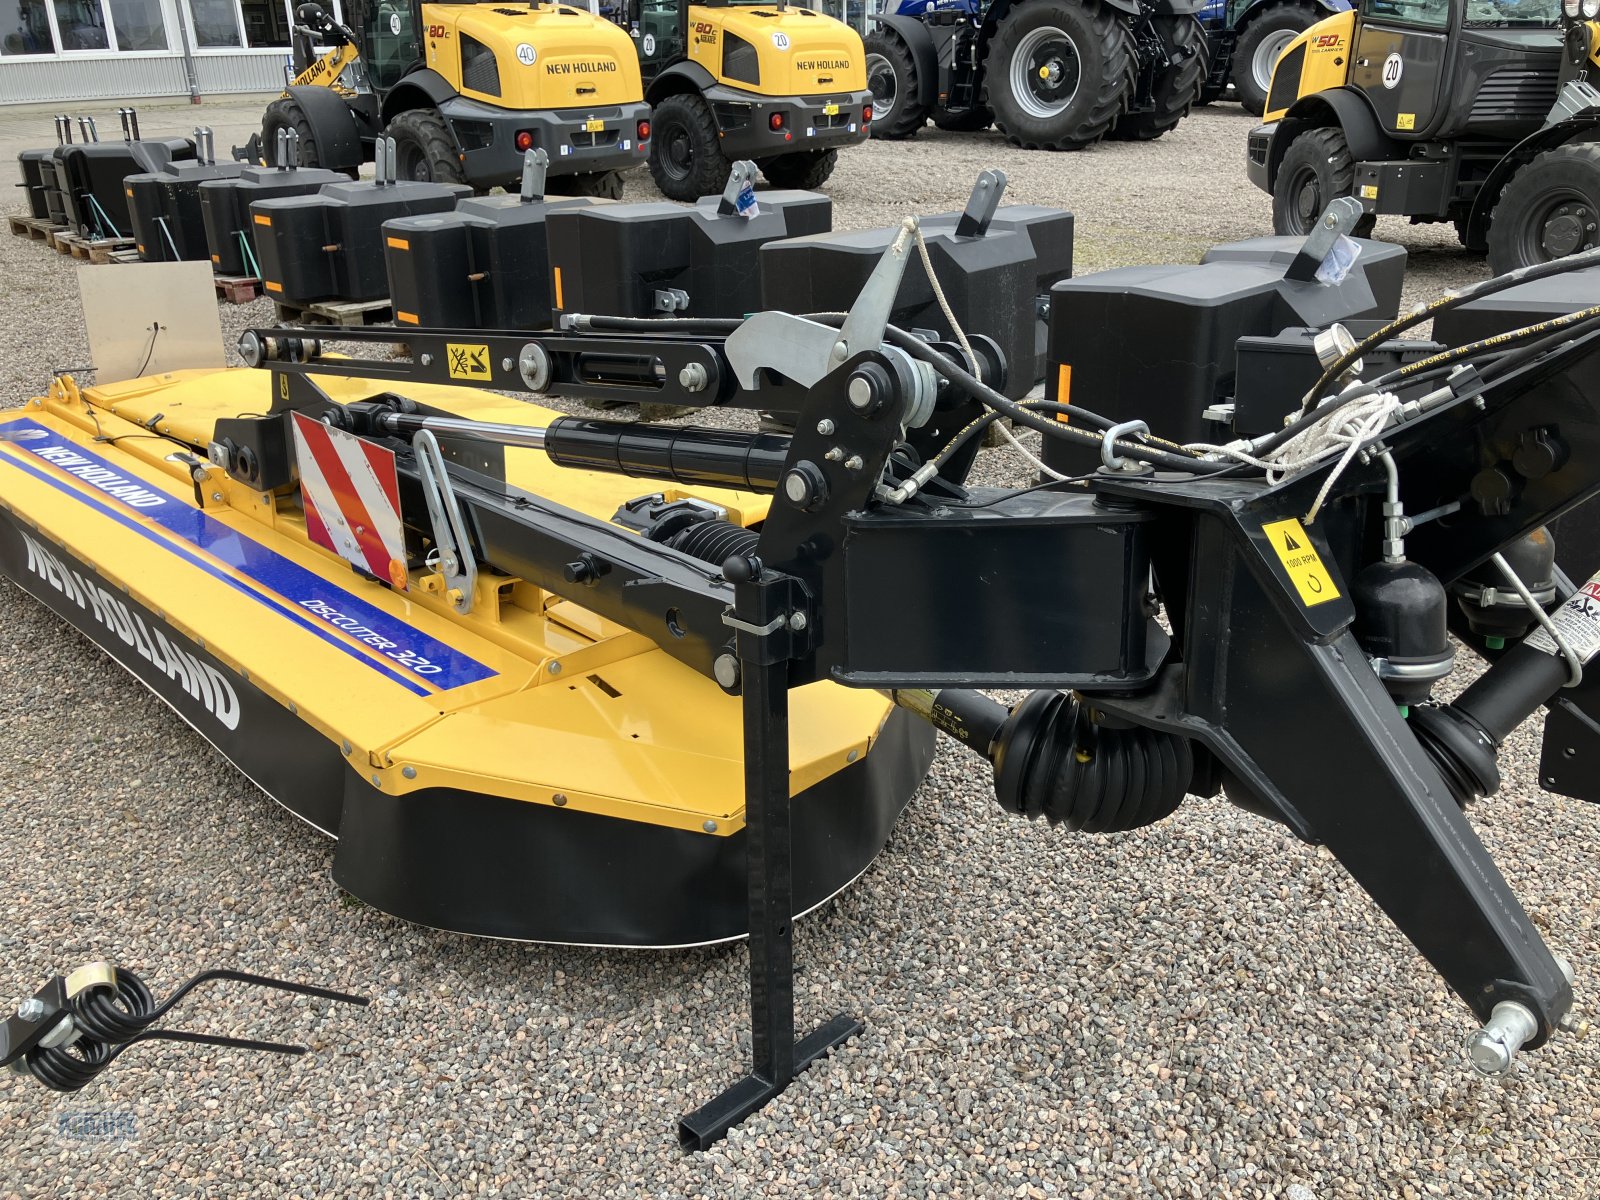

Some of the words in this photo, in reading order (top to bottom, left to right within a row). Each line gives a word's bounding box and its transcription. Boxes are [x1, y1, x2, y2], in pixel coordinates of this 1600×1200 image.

[391, 17, 400, 31] 40
[645, 38, 653, 51] 20
[775, 34, 787, 46] 20
[519, 48, 534, 61] 40
[546, 64, 570, 75] NEW
[573, 62, 616, 74] HOLLAND
[797, 61, 815, 71] NEW
[817, 60, 850, 70] HOLLAND
[1385, 60, 1399, 81] 20
[1400, 350, 1451, 375] DYNAFORCE
[1455, 344, 1469, 355] HK
[1517, 328, 1530, 338] DN
[31, 445, 94, 467] NEW
[66, 464, 167, 507] HOLLAND
[1286, 557, 1303, 569] 1000
[1301, 553, 1318, 565] RPM
[18, 529, 86, 610] NEW
[72, 570, 241, 731] HOLLAND
[298, 599, 398, 650] DISCCUTTER
[386, 649, 443, 674] 320
